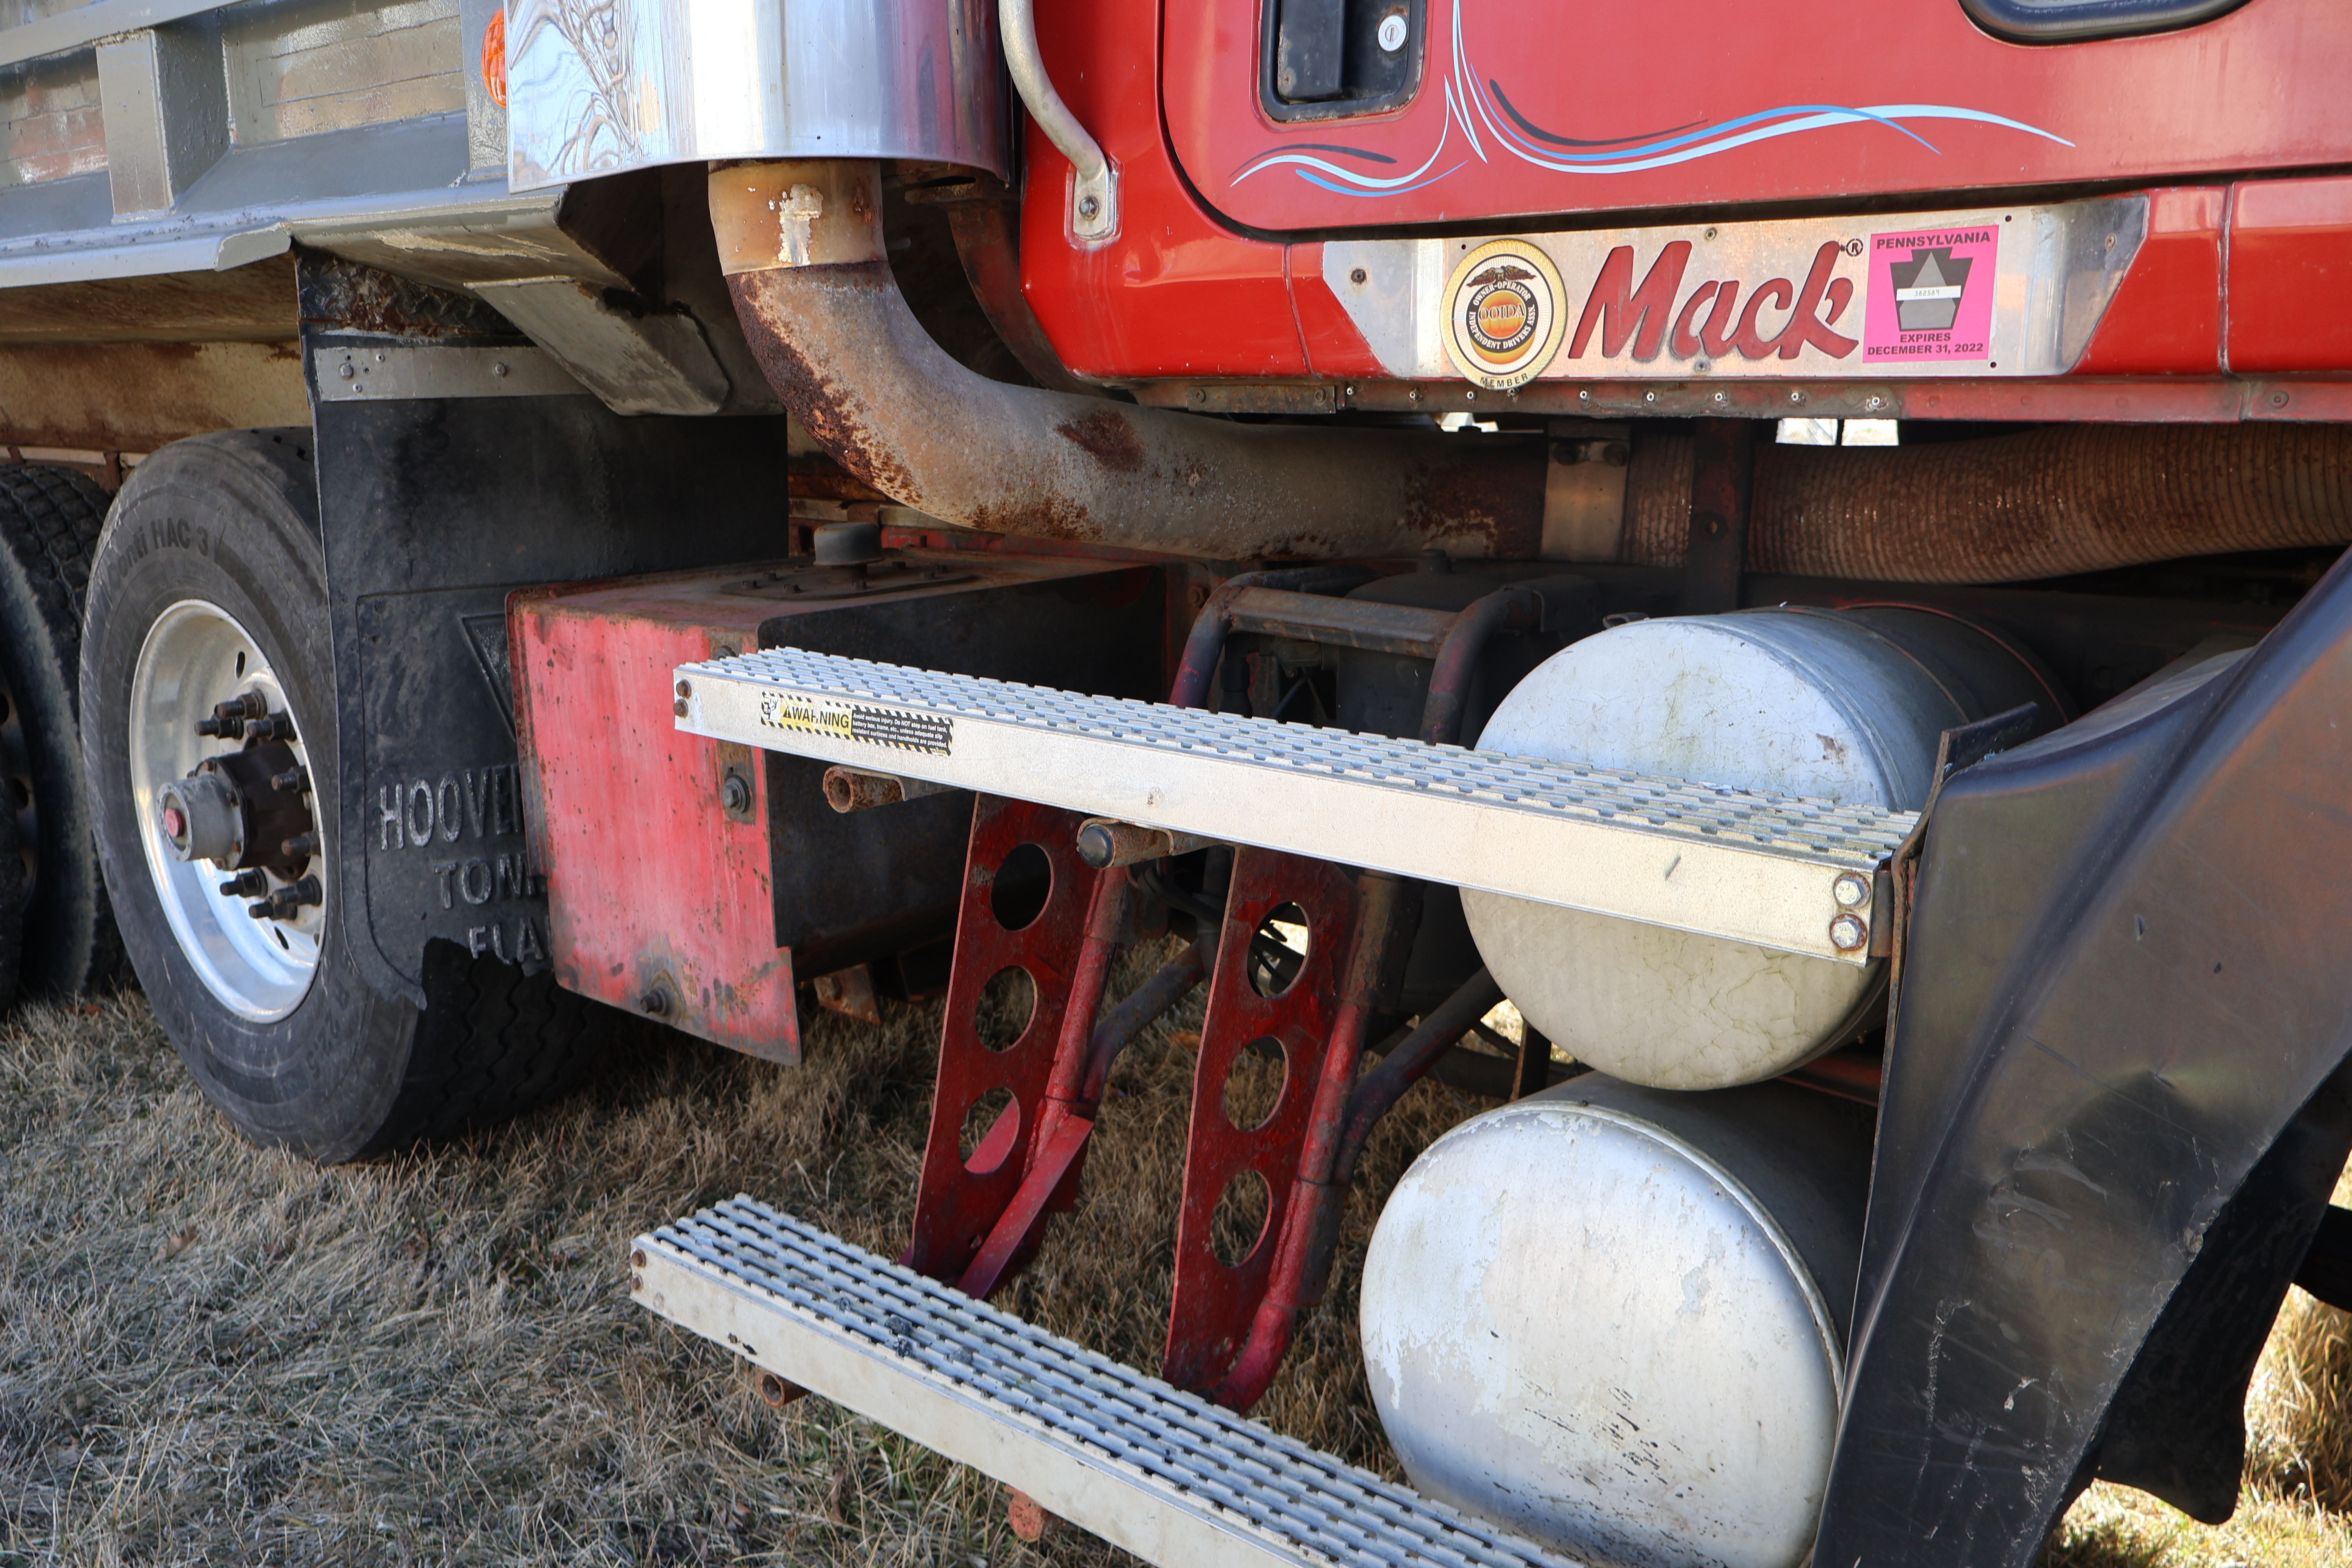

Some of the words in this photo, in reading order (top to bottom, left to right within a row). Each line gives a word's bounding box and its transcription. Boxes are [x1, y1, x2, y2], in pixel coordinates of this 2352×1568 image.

[1877, 230, 1991, 249] PENNSYLVANIA
[1473, 281, 1531, 306] OWNER-OPERATOR
[1479, 303, 1525, 322] OOIDA
[1469, 312, 1501, 349] INDEPENDENT
[1503, 326, 1531, 349] DRIVERS
[1900, 332, 1951, 343] EXPIRES
[1868, 345, 1932, 355] DECEMBER
[1936, 344, 1951, 354] 31,
[1955, 343, 1984, 352] 2022
[1480, 372, 1528, 388] MEMBER
[150, 517, 191, 549] HAC
[197, 526, 209, 557] 3
[792, 706, 849, 728] WARNING
[853, 720, 866, 729] battery
[877, 724, 889, 732] frame,
[915, 730, 934, 739] adequate
[897, 733, 919, 743] handholds
[927, 740, 947, 748] provided.
[469, 915, 552, 965] FLA
